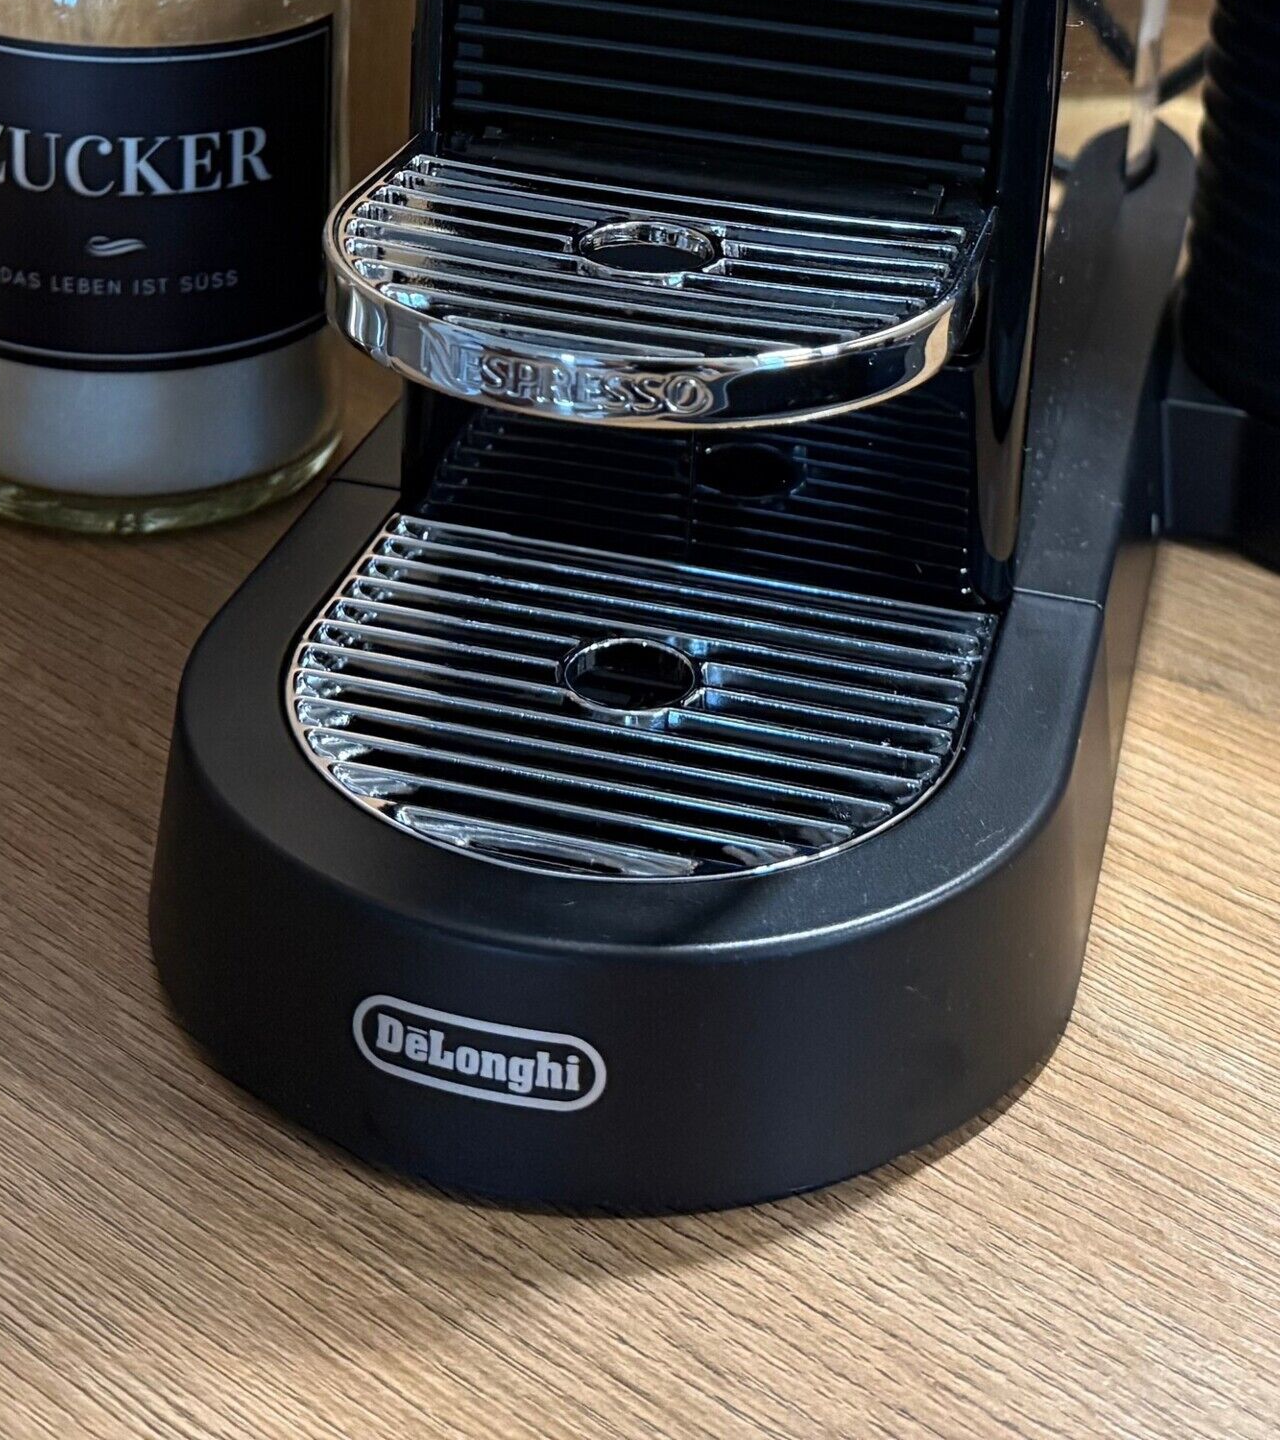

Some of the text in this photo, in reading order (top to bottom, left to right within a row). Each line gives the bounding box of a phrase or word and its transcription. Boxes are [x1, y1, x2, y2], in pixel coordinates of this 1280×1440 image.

[0, 267, 238, 296] DAS LEBEN IST SÜSS
[421, 324, 714, 414] NESPRESSO
